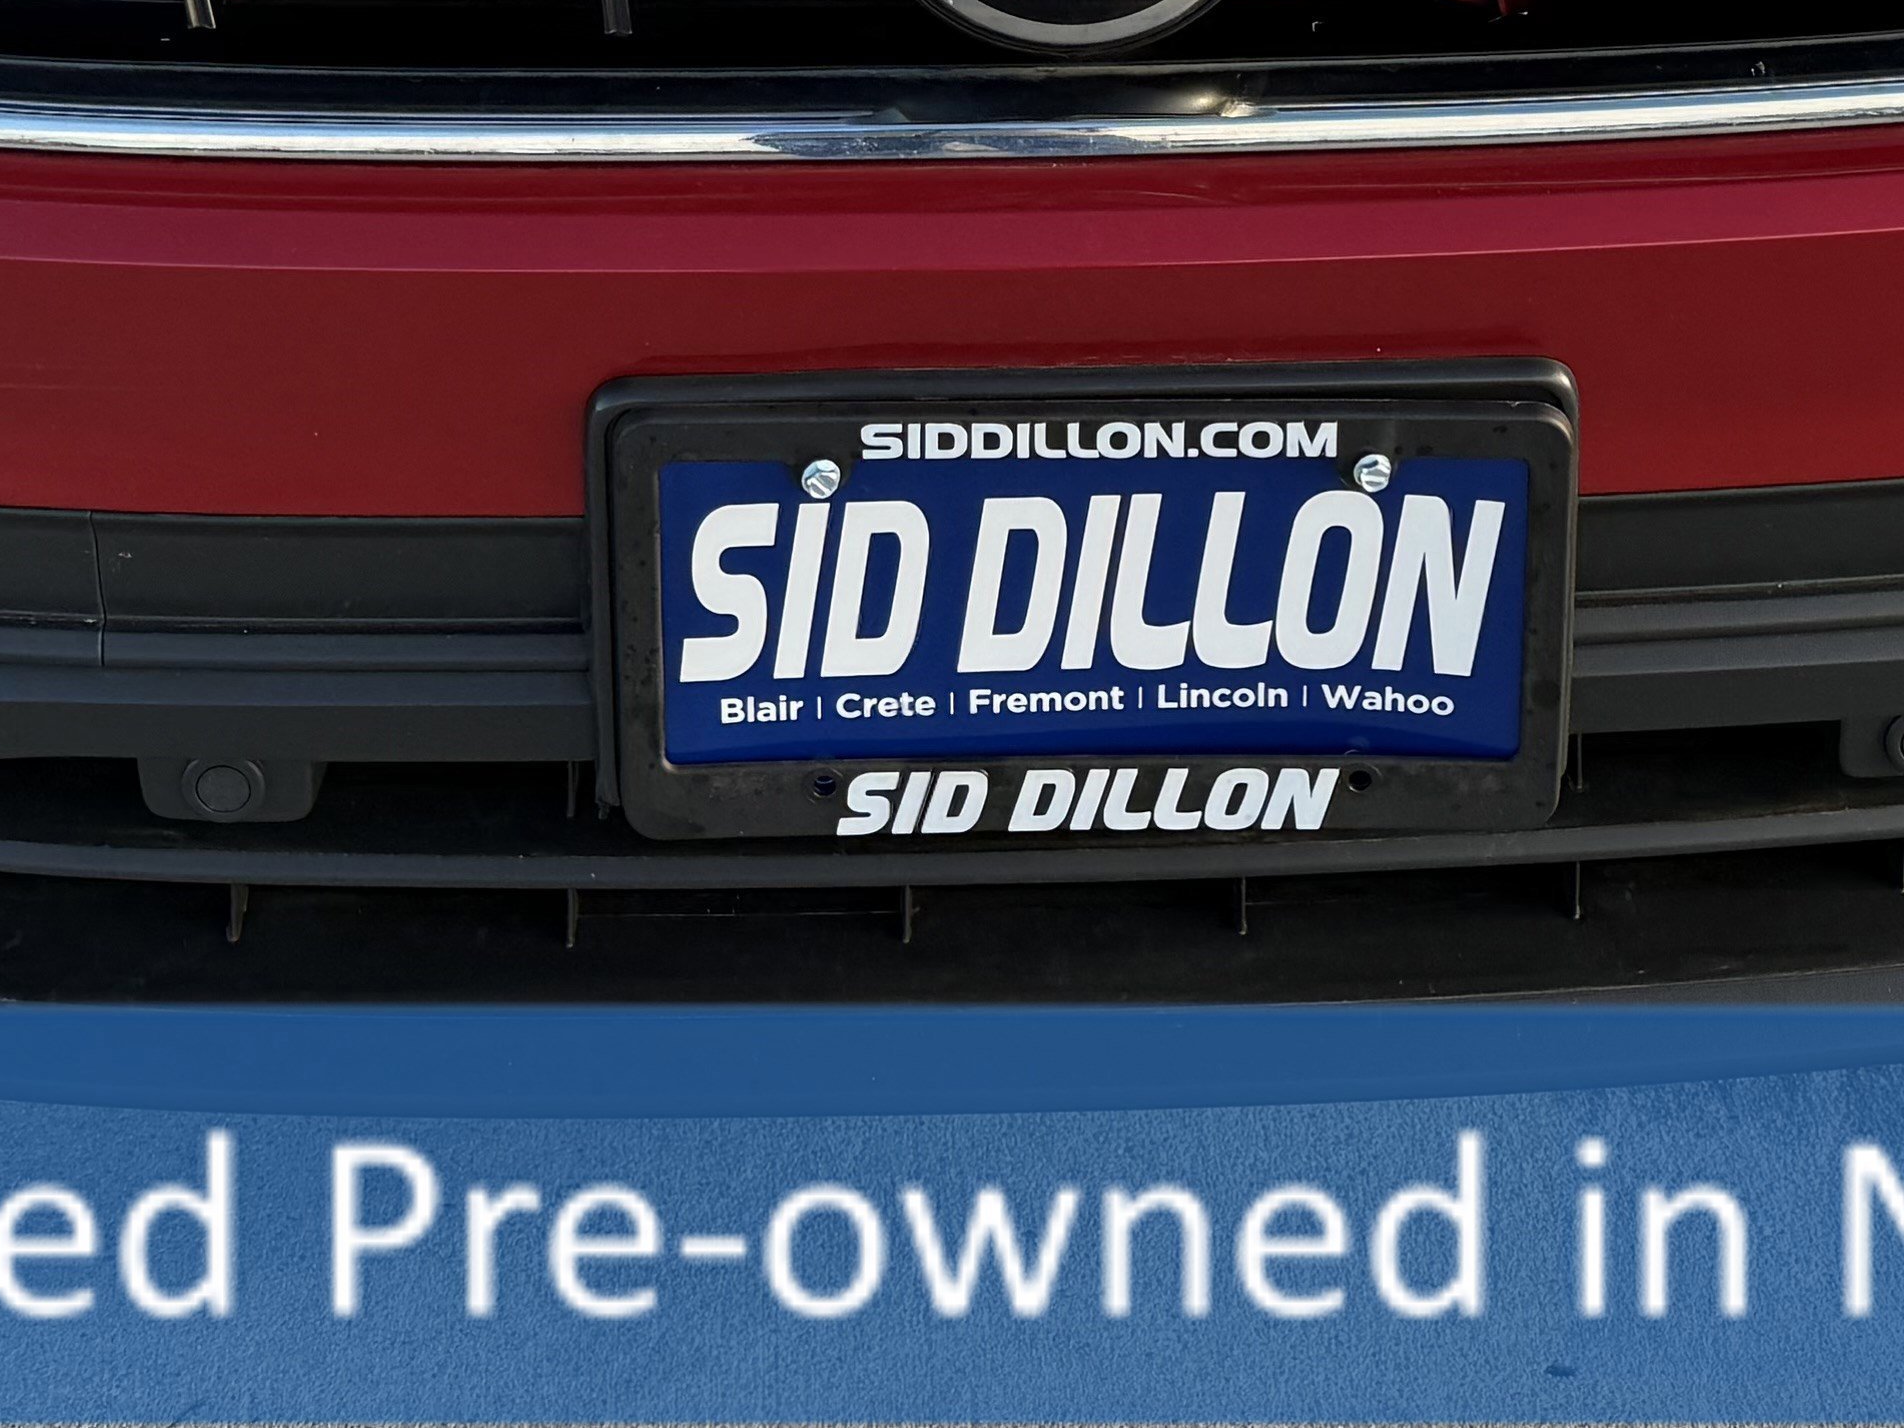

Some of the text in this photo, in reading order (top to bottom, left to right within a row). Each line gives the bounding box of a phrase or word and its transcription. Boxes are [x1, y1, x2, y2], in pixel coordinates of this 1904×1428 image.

[859, 420, 1339, 461] SIDDILLON.COM
[677, 490, 1507, 684] SID DILLON
[719, 682, 1456, 725] Blair Crete Fremont Lincoln Wahoo
[835, 766, 1341, 837] SID DILLON
